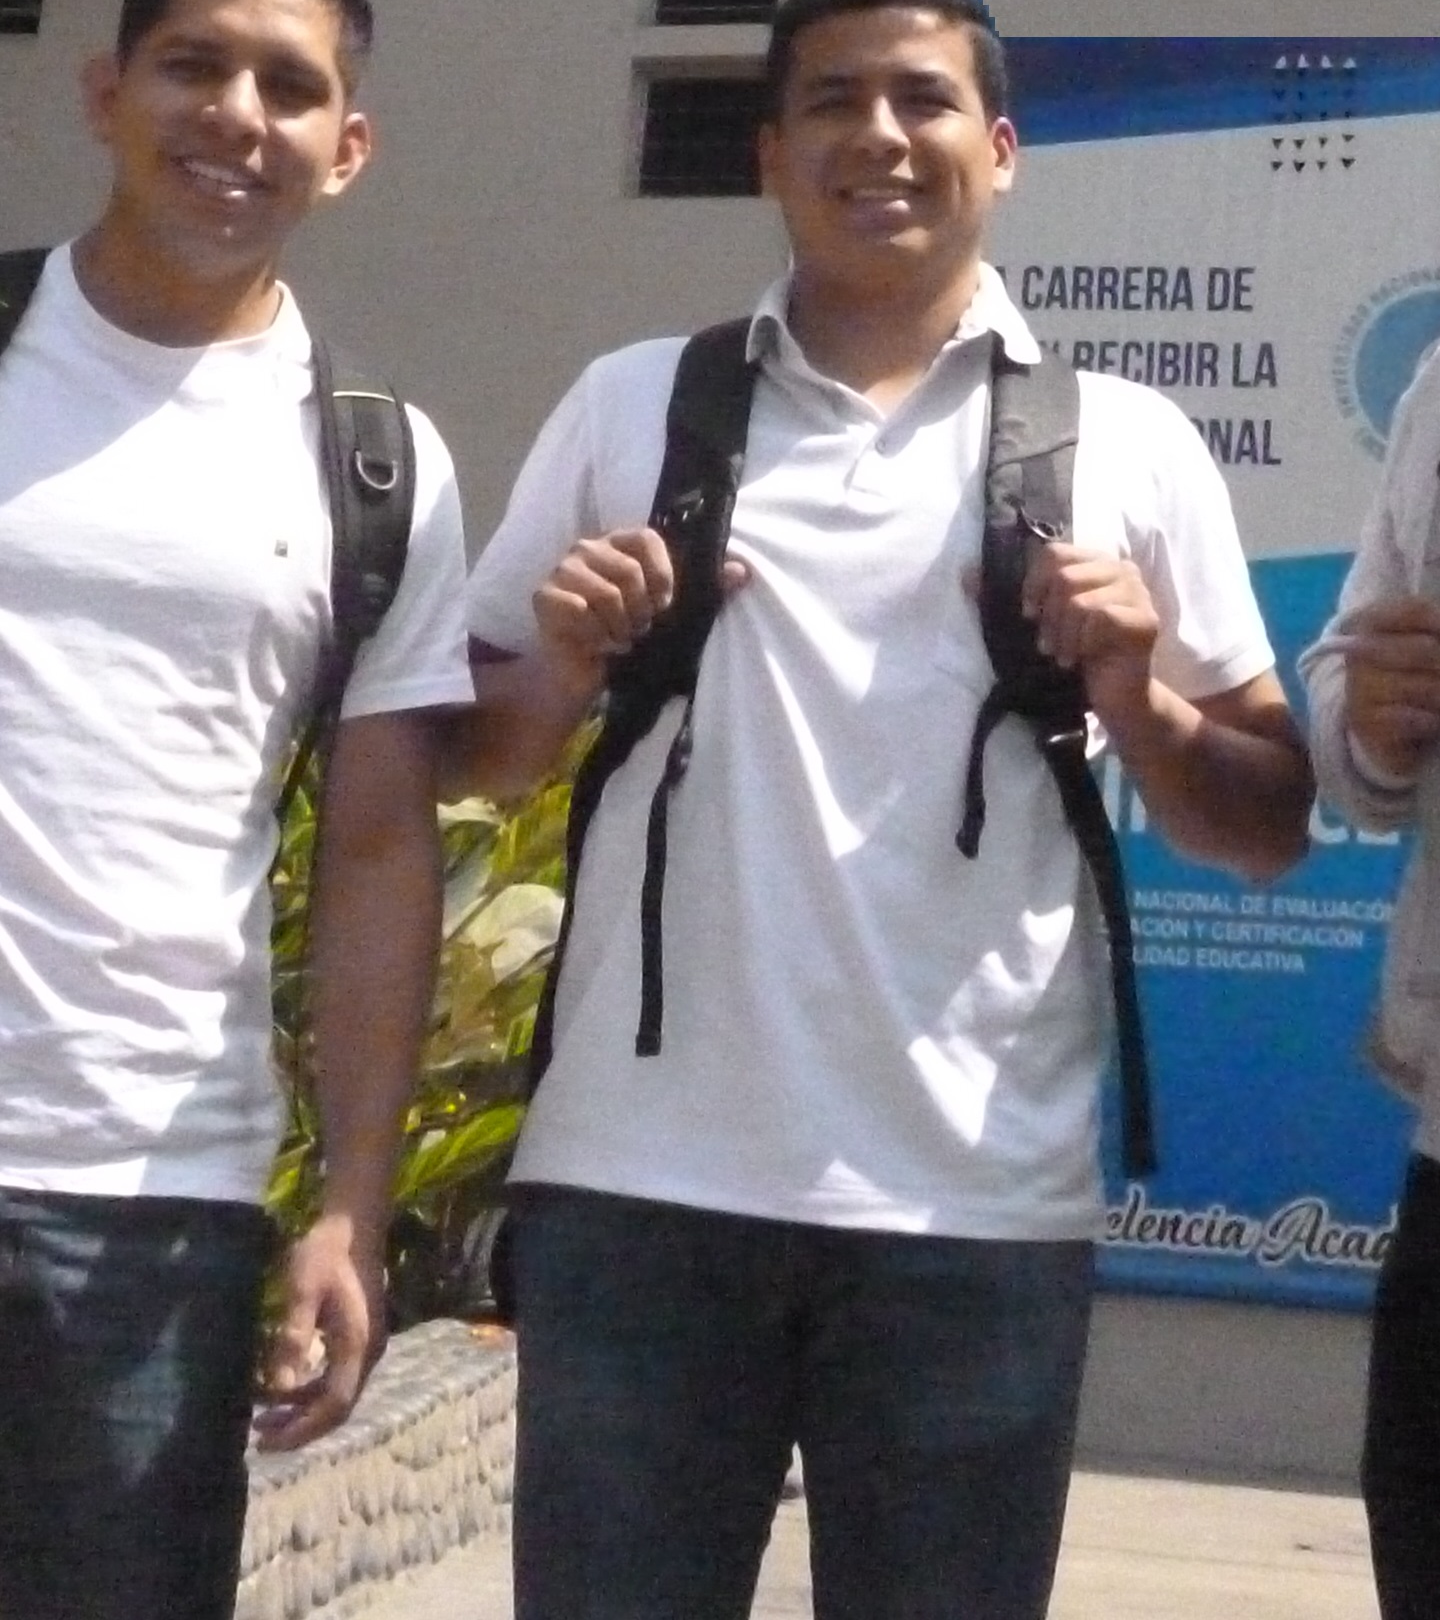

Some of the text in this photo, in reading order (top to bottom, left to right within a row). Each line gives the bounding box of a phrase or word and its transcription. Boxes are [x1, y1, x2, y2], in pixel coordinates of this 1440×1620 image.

[1021, 265, 1256, 312] CARRERA DE
[1071, 340, 1279, 387] RECIBIR LA
[1133, 890, 1234, 914] NACIONAL
[1240, 895, 1267, 916] DE
[1193, 920, 1205, 940] Y
[1196, 947, 1306, 973] EDUCATIVA
